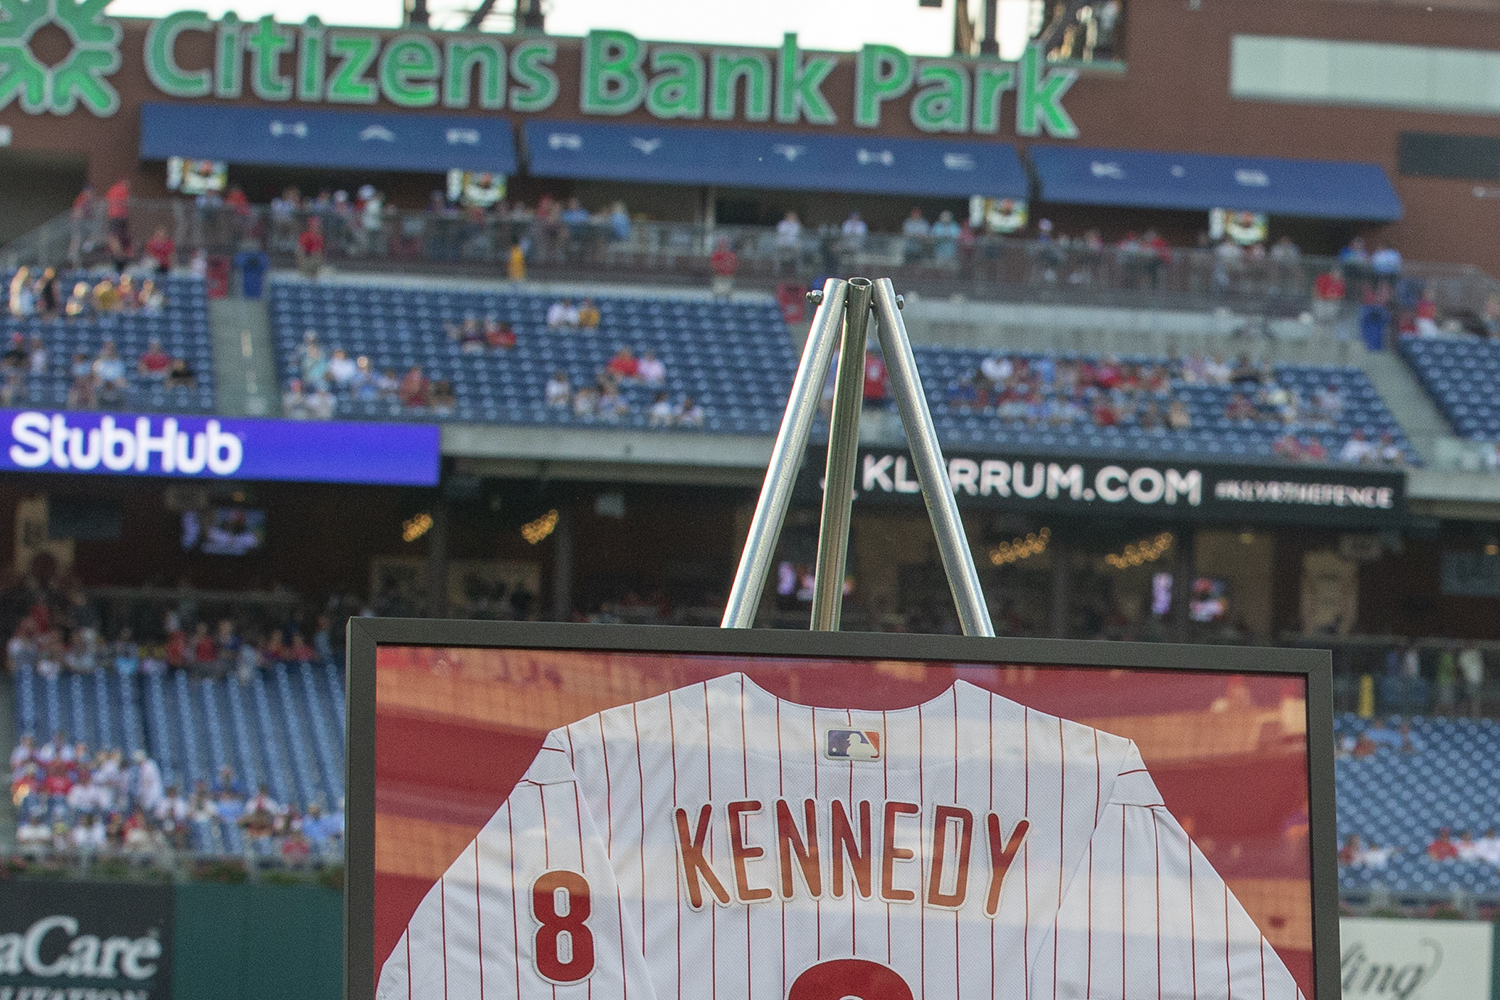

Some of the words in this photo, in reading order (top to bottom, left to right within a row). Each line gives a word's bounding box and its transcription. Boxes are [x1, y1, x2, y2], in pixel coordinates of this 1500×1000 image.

[143, 10, 560, 112] Citizens
[580, 28, 838, 124] Bank
[854, 40, 1080, 138] Park
[9, 411, 244, 475] StubHub
[862, 453, 1202, 507] KLRRUM.COM
[672, 798, 1031, 919] KENNEDY
[529, 868, 597, 986] 8
